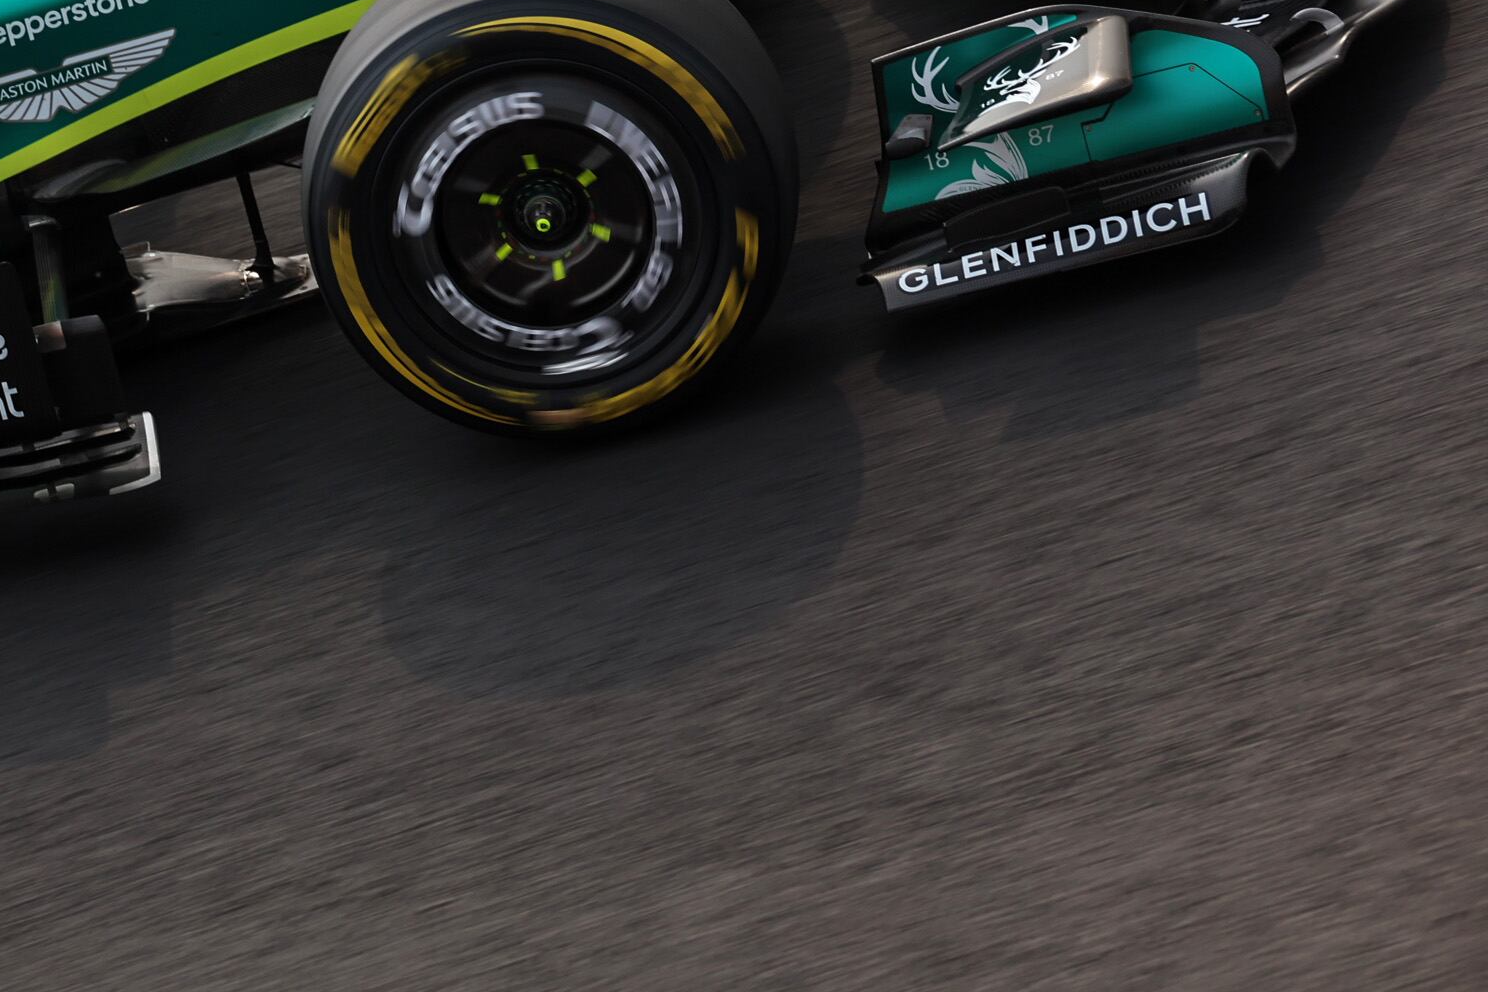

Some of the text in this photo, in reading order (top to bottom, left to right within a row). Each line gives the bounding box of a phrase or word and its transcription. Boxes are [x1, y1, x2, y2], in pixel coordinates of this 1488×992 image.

[0, 60, 108, 101] ASTON MARTIN
[924, 124, 1054, 171] 18 87
[898, 192, 1211, 293] GLENFIDDICH
